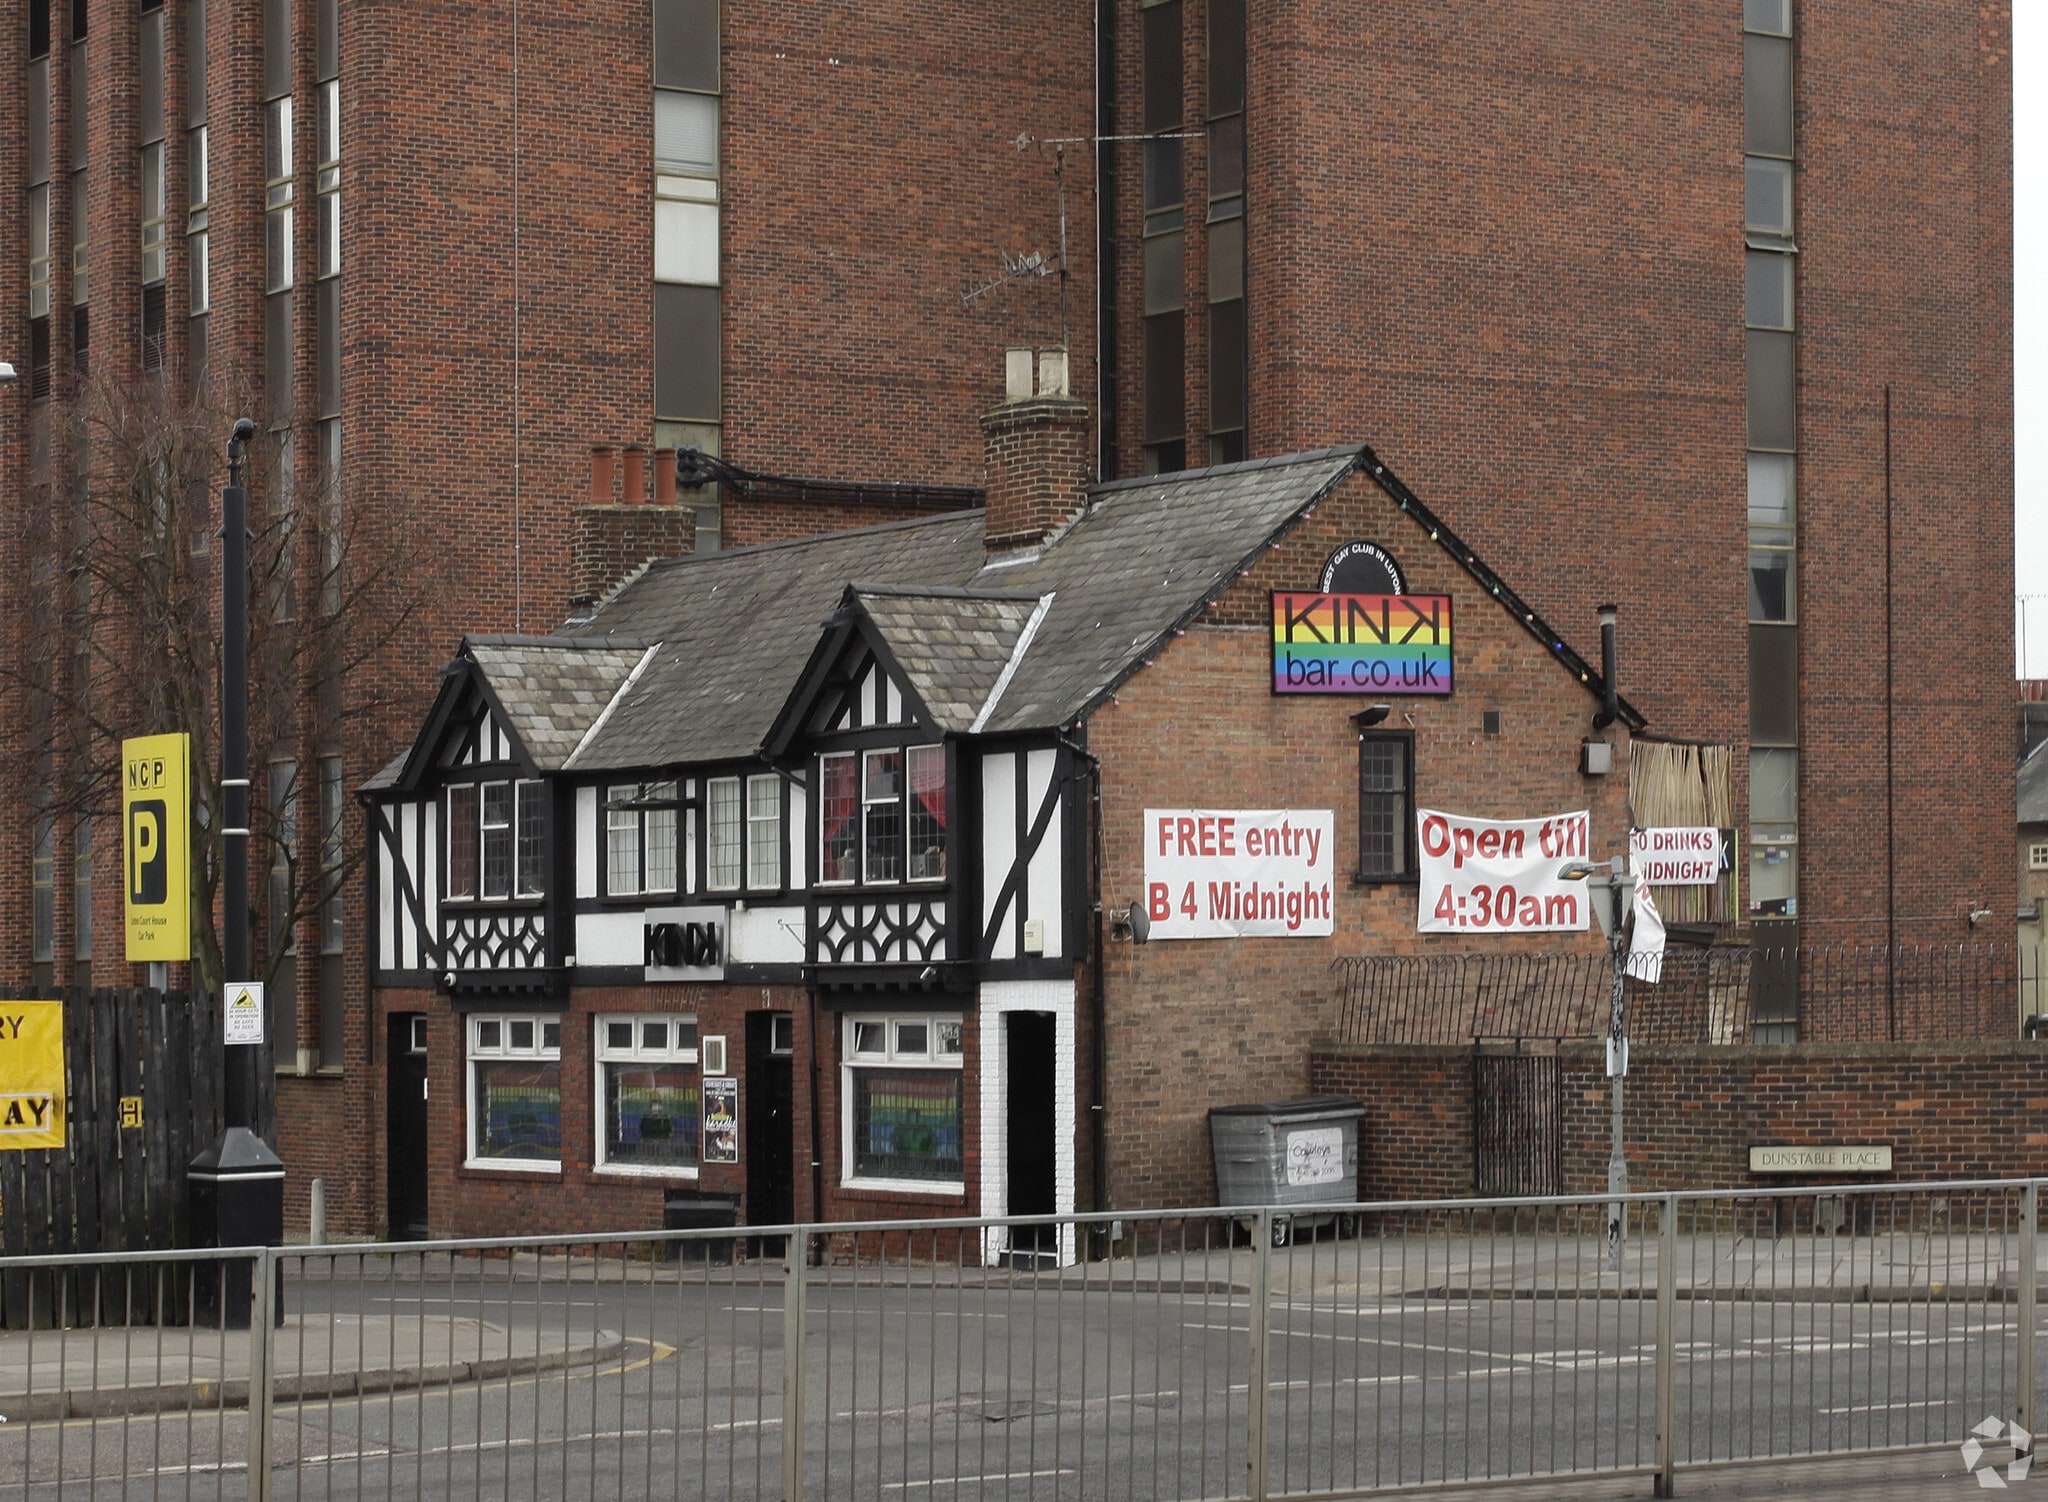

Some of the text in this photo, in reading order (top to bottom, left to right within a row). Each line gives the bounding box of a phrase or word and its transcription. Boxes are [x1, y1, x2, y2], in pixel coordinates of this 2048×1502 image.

[1323, 544, 1401, 595] BEST GAY CLUB IN LUTON
[1285, 597, 1440, 645] KINK
[1286, 650, 1439, 687] bar.co.uk
[129, 760, 164, 787] NCP
[133, 810, 159, 895] P
[1158, 817, 1322, 867] FREE entry
[1422, 815, 1587, 869] Open till
[1653, 832, 1713, 851] DRINKS
[1149, 881, 1330, 930] B 4 Midnight
[1434, 884, 1577, 927] 4:30am
[1762, 1152, 1881, 1166] DUNSTABLE PLACE
